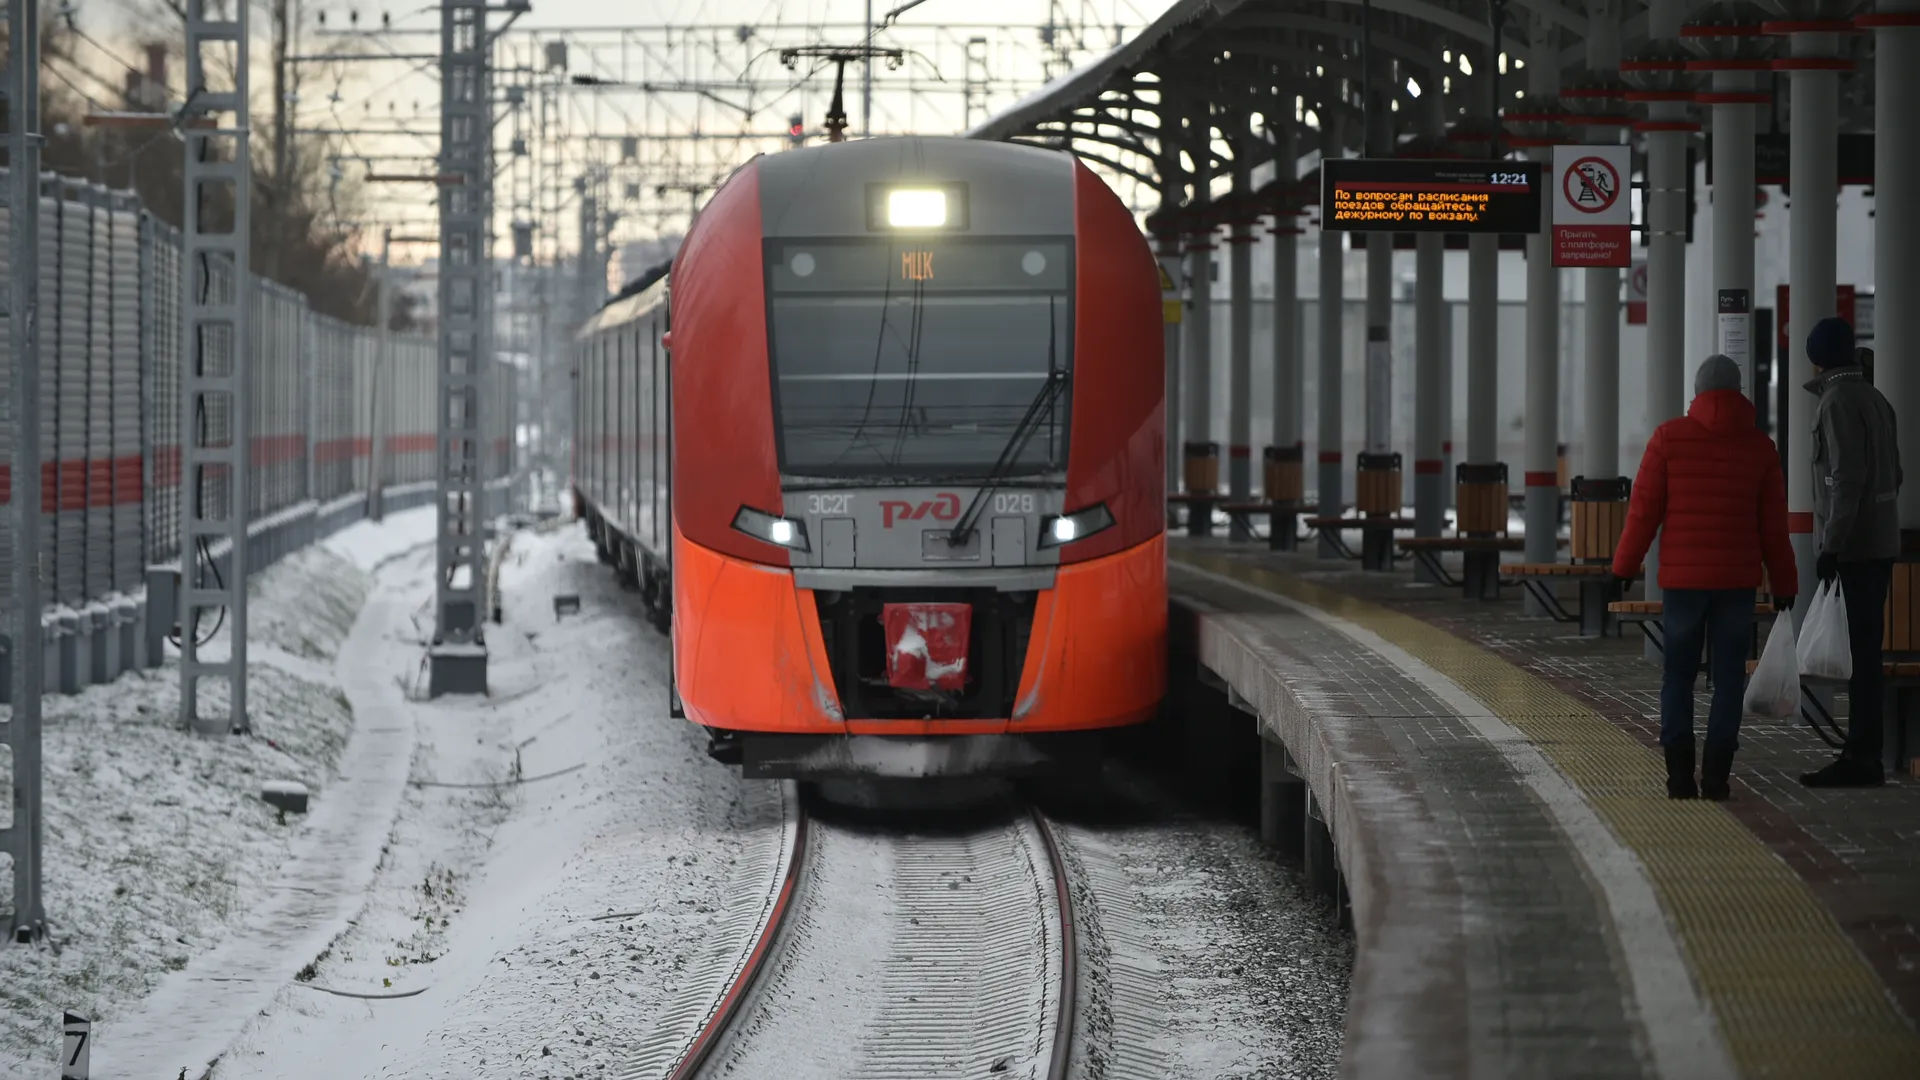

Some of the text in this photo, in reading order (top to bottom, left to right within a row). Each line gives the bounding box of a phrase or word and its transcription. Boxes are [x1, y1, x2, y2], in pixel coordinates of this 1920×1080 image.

[1490, 172, 1528, 185] 12:21
[1335, 189, 1488, 202] По вопросам расписания
[1335, 200, 1486, 212] поездов обращайтесь к
[1335, 210, 1479, 222] дежурному по вокзалу.
[1560, 229, 1597, 239] Прыгать
[1568, 240, 1619, 250] платформы
[1560, 250, 1612, 261] запрещено!
[902, 252, 933, 280] МЦК
[1741, 295, 1746, 307] 1
[995, 494, 1033, 513] 028
[65, 1031, 88, 1066] 7
